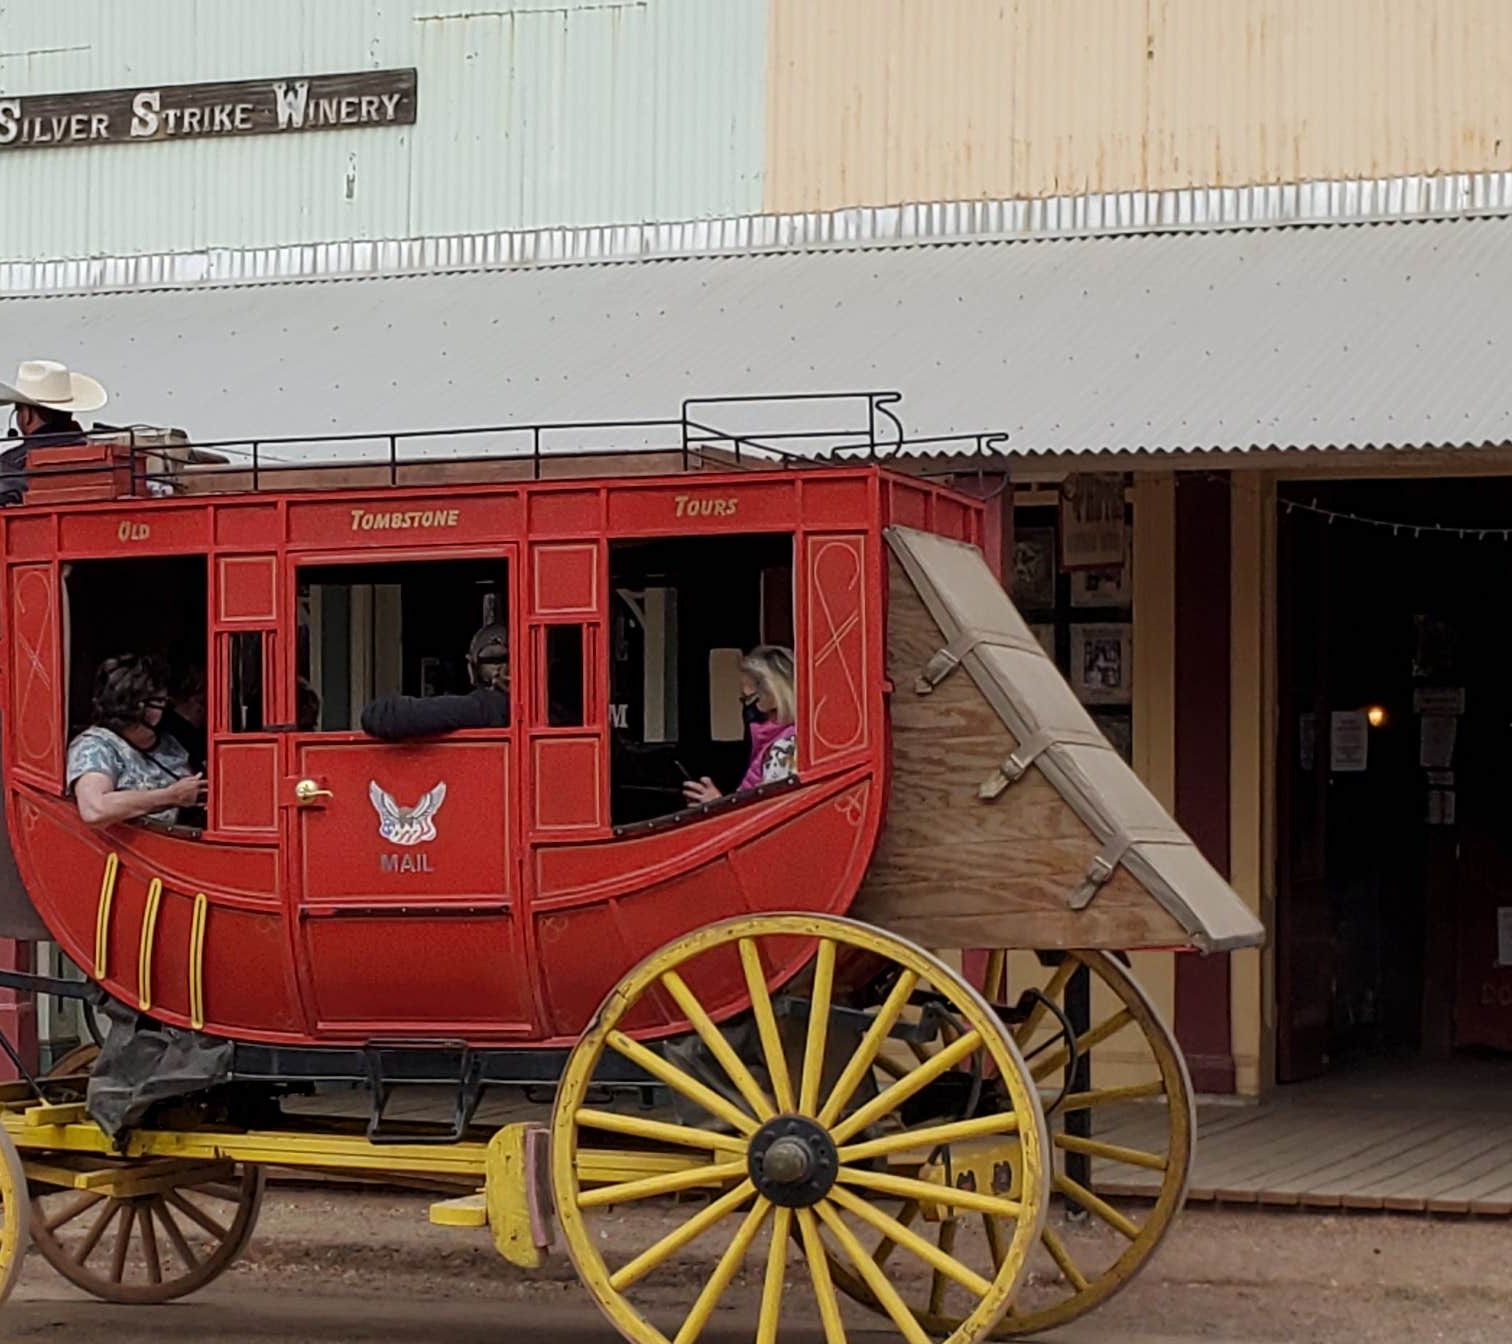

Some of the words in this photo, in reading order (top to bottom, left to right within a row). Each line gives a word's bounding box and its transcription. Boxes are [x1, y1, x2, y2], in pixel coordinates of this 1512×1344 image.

[130, 91, 254, 137] STRIKE
[273, 81, 402, 129] WINERY
[118, 520, 150, 544] OLD
[351, 510, 460, 531] TOMBSTONE
[675, 495, 738, 518] TOURS
[379, 854, 434, 874] MAIL
